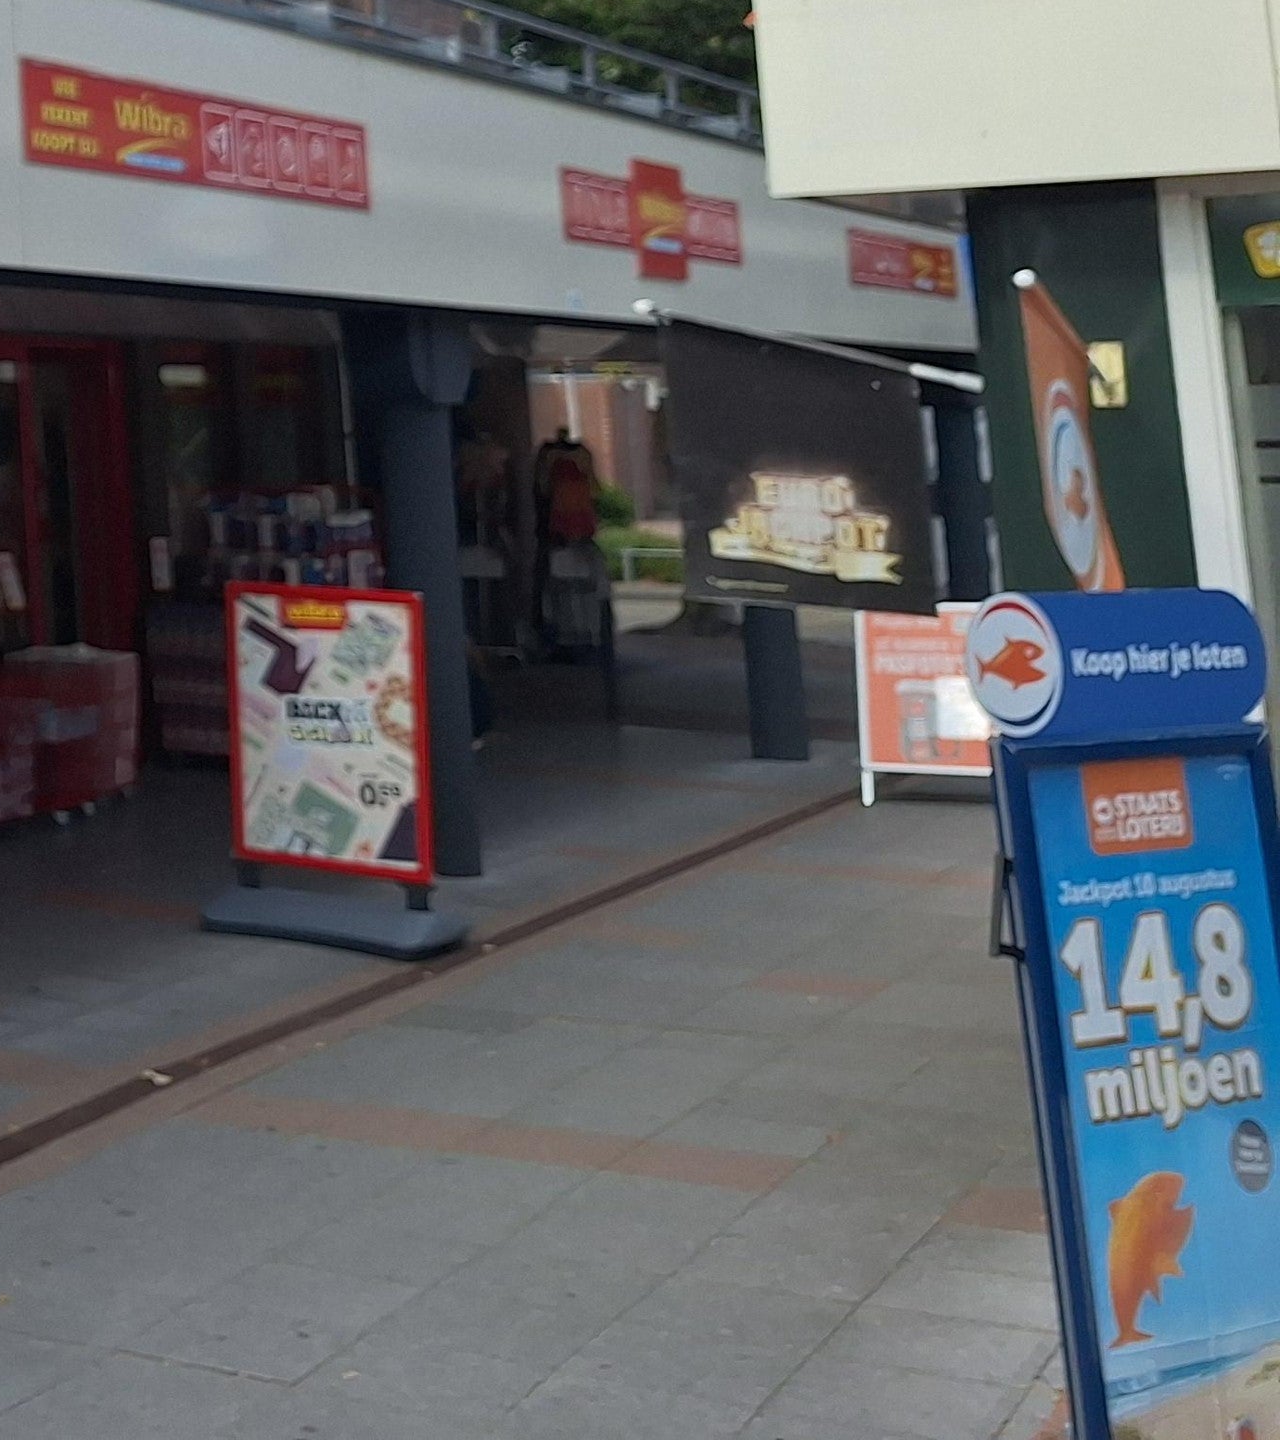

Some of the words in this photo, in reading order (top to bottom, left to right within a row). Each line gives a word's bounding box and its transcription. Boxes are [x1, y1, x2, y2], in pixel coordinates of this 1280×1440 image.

[114, 97, 190, 140] Wibra
[1070, 647, 1128, 682] Koop
[1126, 642, 1170, 674] hier
[1168, 641, 1191, 679] je
[1191, 641, 1248, 671] loten
[1113, 789, 1183, 817] STAATS
[1058, 876, 1132, 907] Jackpot
[1059, 901, 1253, 1052] 14,8
[1084, 1044, 1264, 1131] miljoen
